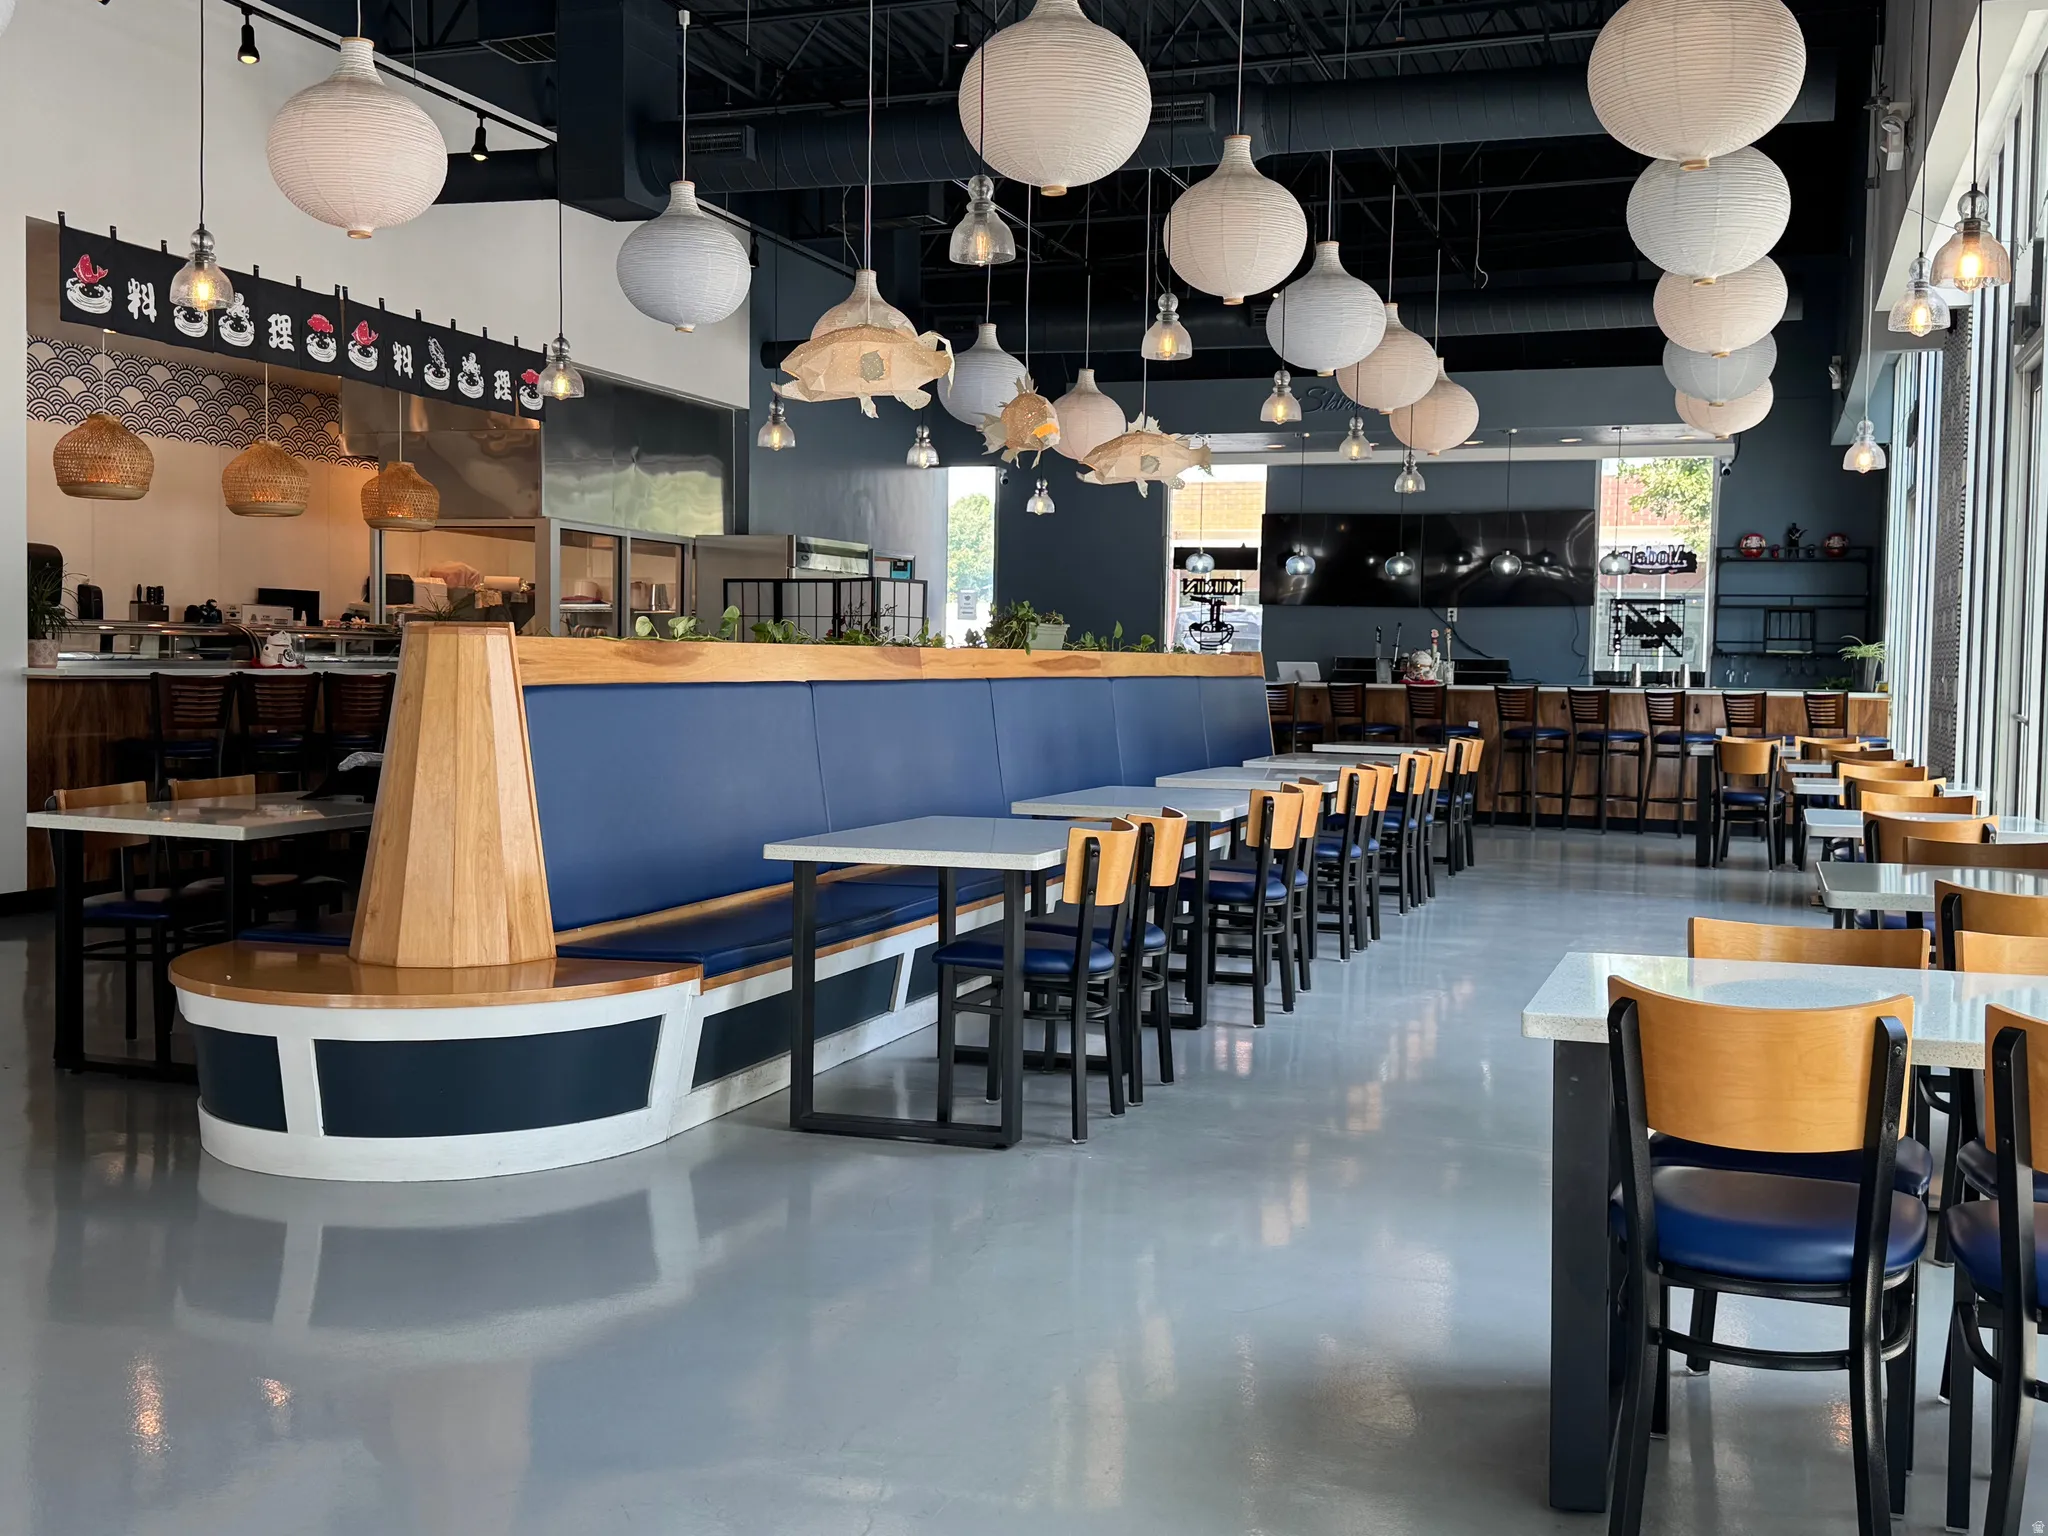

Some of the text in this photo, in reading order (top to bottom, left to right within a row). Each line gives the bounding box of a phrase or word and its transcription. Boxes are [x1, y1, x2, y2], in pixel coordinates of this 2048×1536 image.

[127, 278, 157, 323] 料
[267, 312, 295, 351] 理
[392, 341, 414, 379] 料
[494, 369, 513, 401] 理
